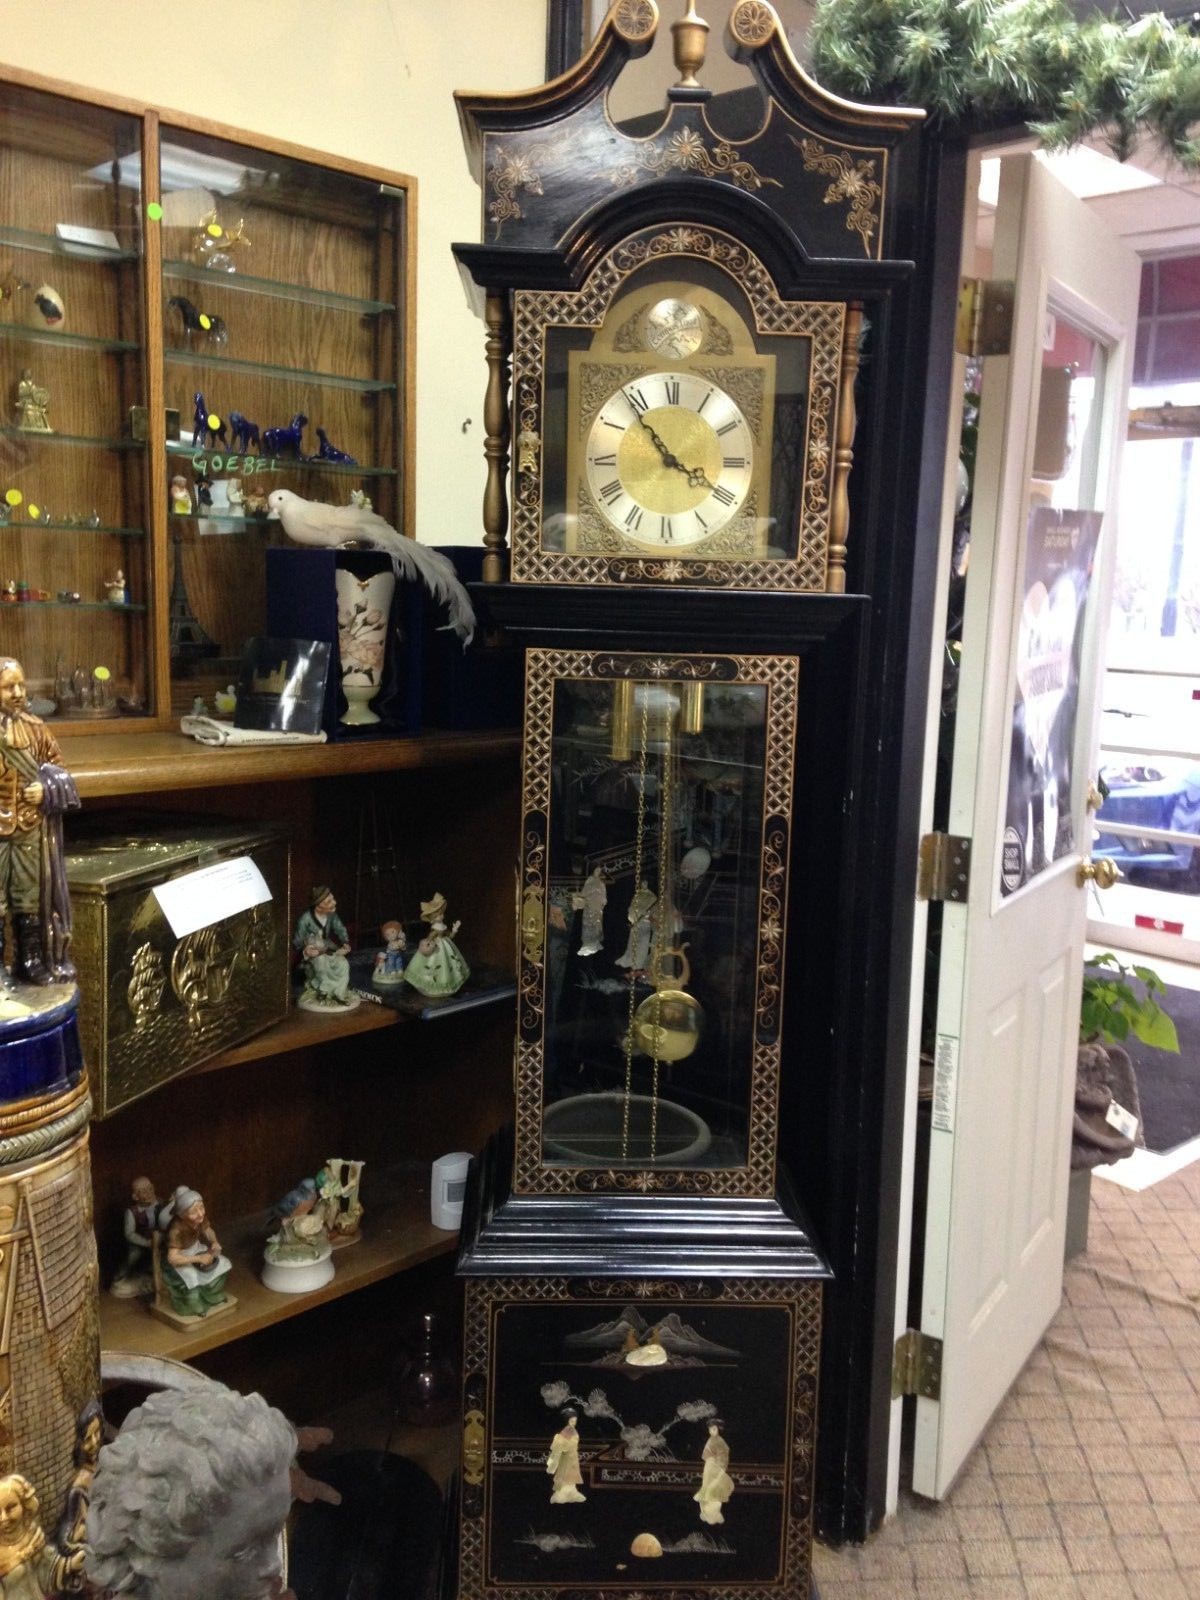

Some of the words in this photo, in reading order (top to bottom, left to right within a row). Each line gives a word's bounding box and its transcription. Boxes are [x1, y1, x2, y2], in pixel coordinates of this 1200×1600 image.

[715, 420, 738, 437] II
[192, 453, 280, 476] GOEBEL
[722, 456, 745, 468] III
